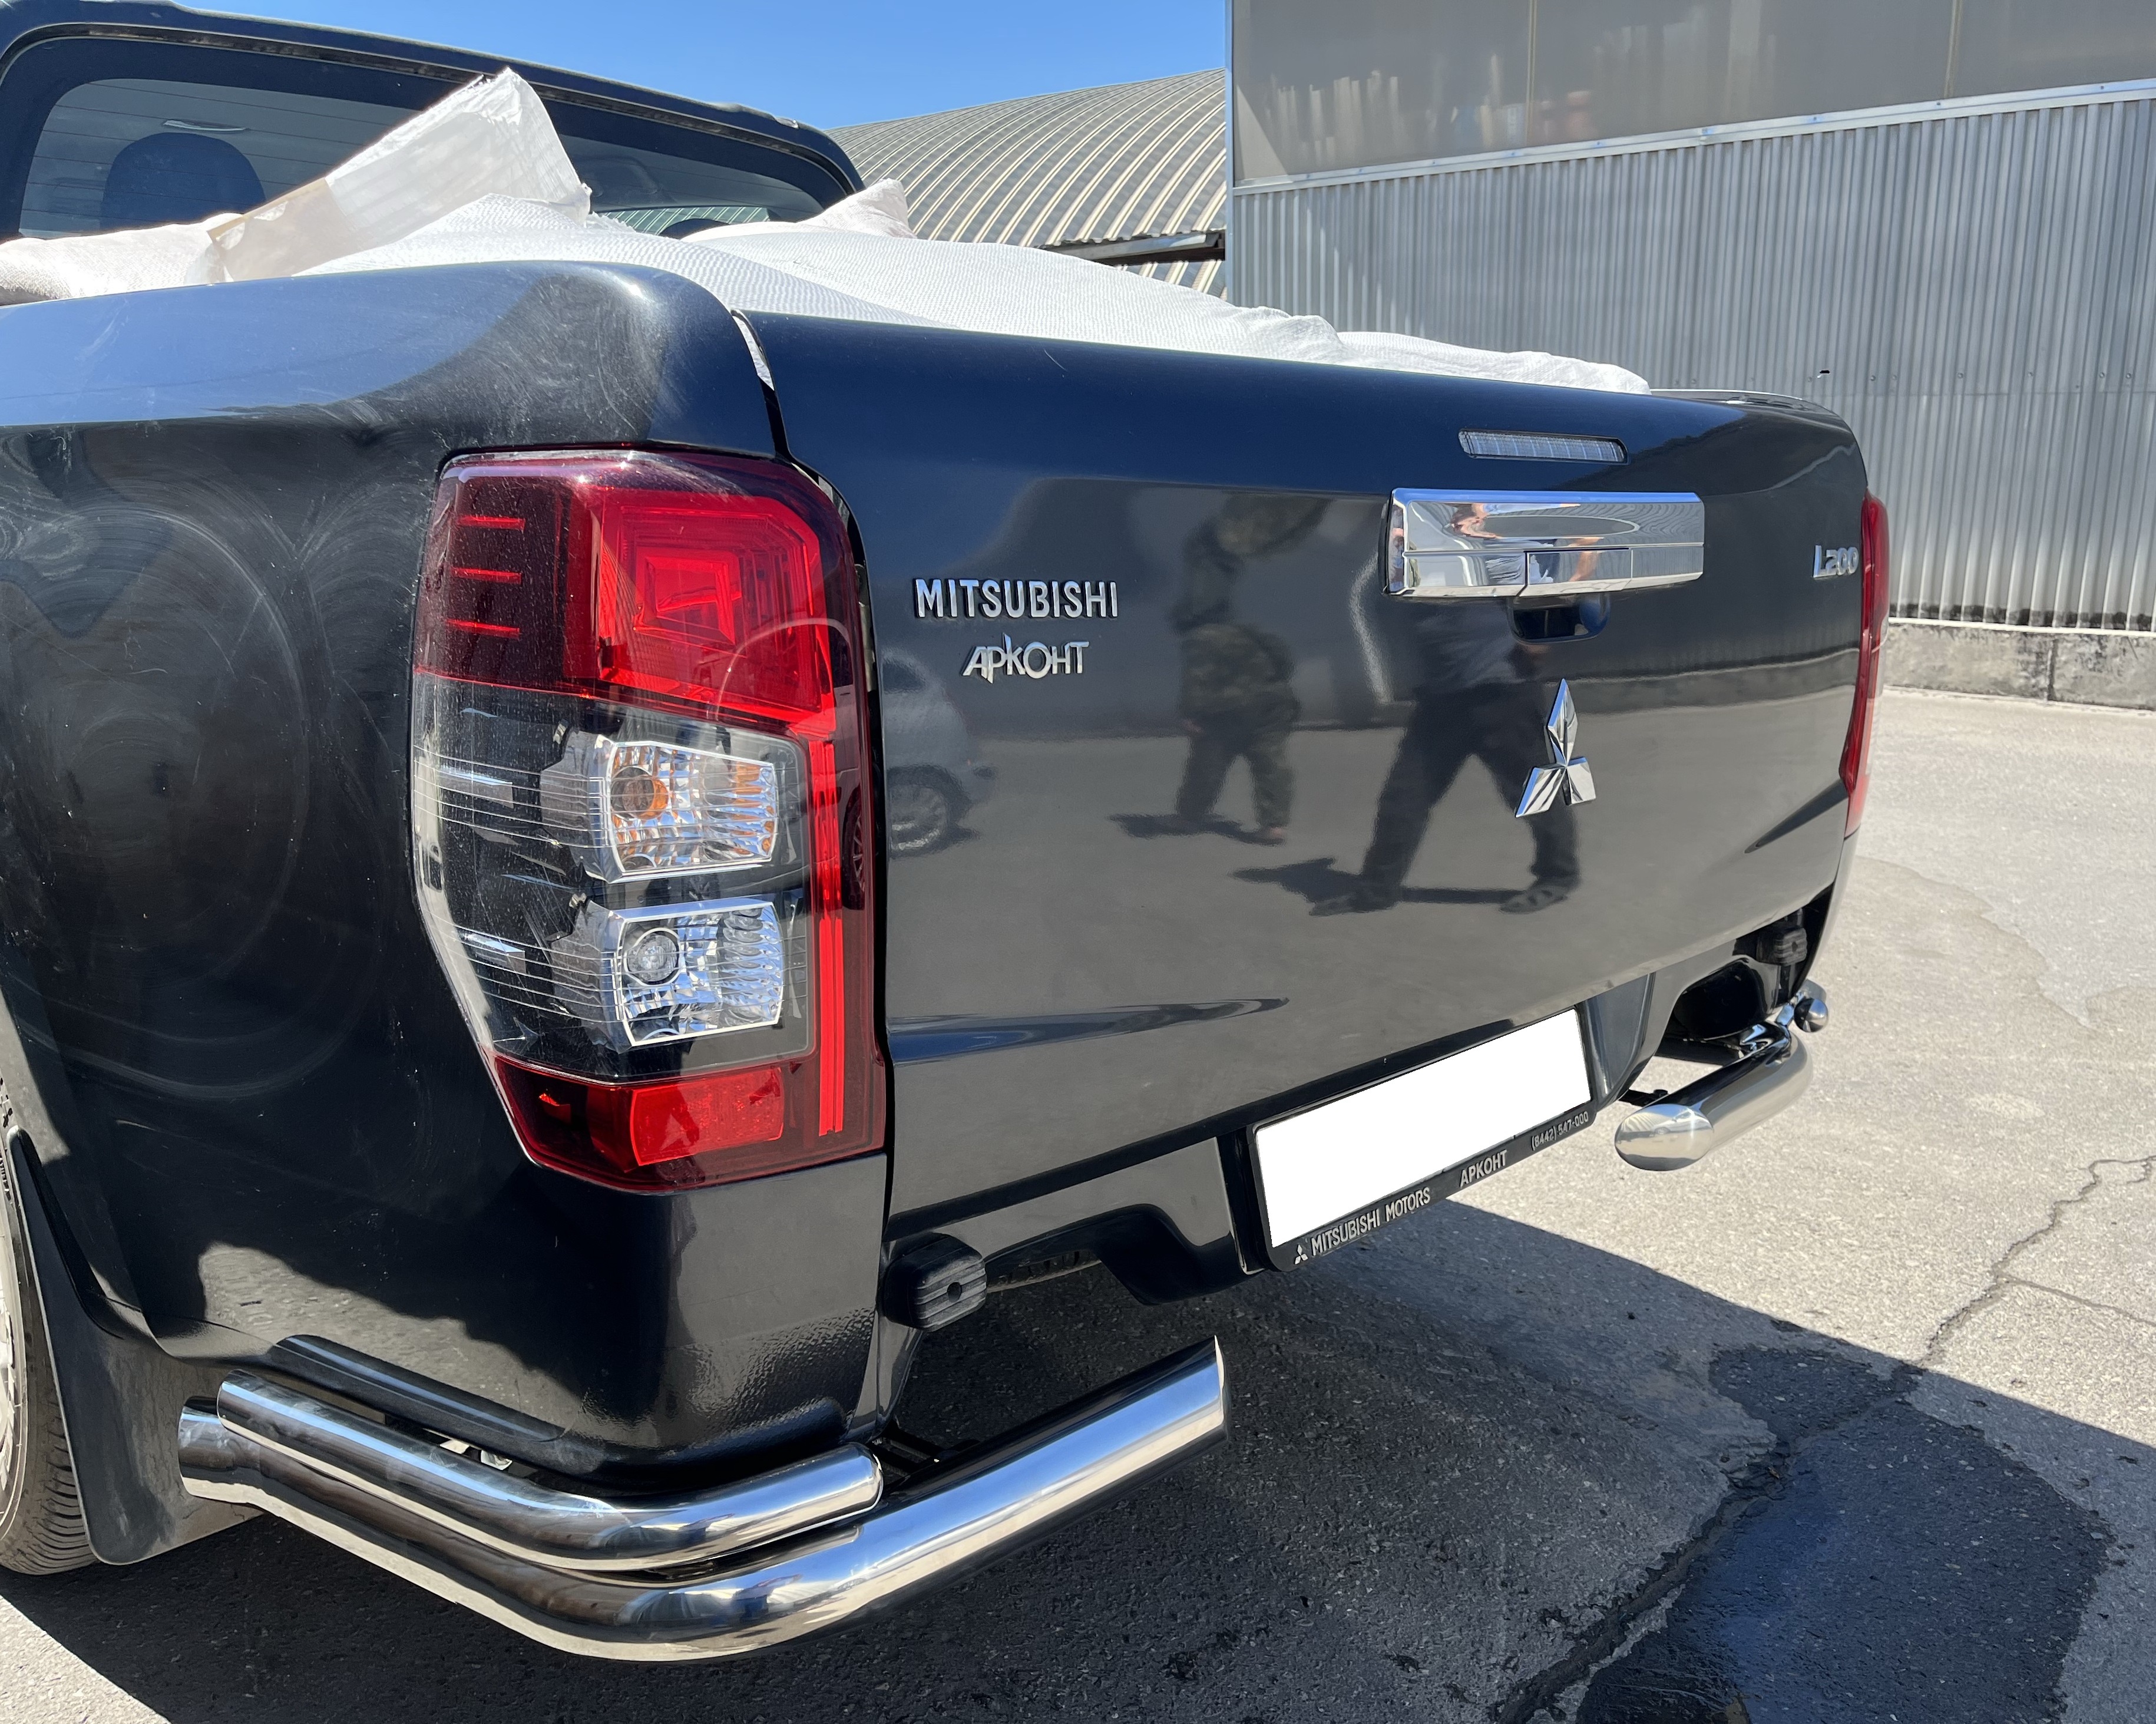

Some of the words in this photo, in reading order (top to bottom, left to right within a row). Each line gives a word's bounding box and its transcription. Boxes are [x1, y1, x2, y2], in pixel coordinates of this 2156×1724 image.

[1813, 544, 1859, 579] L200
[914, 578, 1118, 618] MITSUBISHI
[1532, 1125, 1556, 1151] (8442)
[1558, 1111, 1589, 1136] 547-000
[1310, 1208, 1381, 1256] MITSUBISHI
[1385, 1187, 1431, 1222] MOTORS
